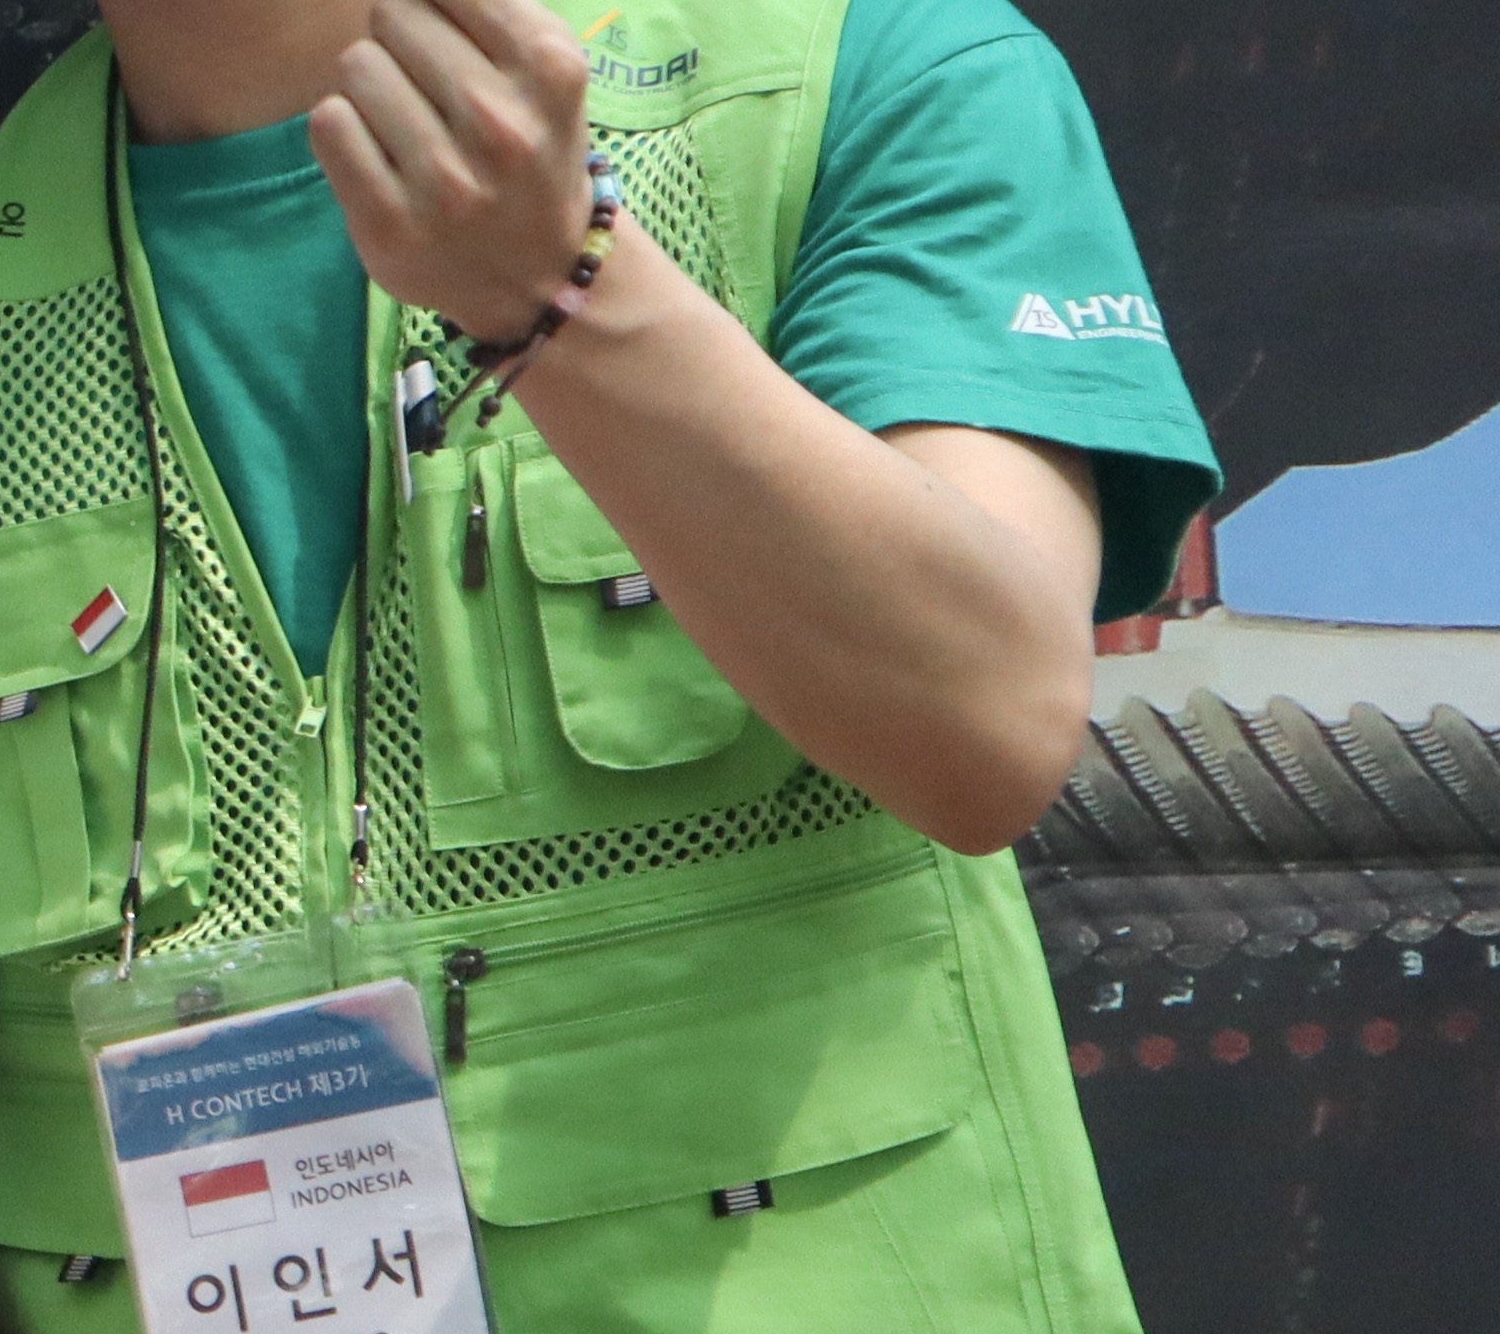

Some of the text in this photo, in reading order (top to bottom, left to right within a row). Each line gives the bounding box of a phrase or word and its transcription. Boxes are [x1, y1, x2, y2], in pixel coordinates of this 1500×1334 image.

[166, 1063, 369, 1126] H CONTECH 제3기
[295, 1140, 396, 1181] 인도네시아
[290, 1168, 414, 1209] INDONESIA
